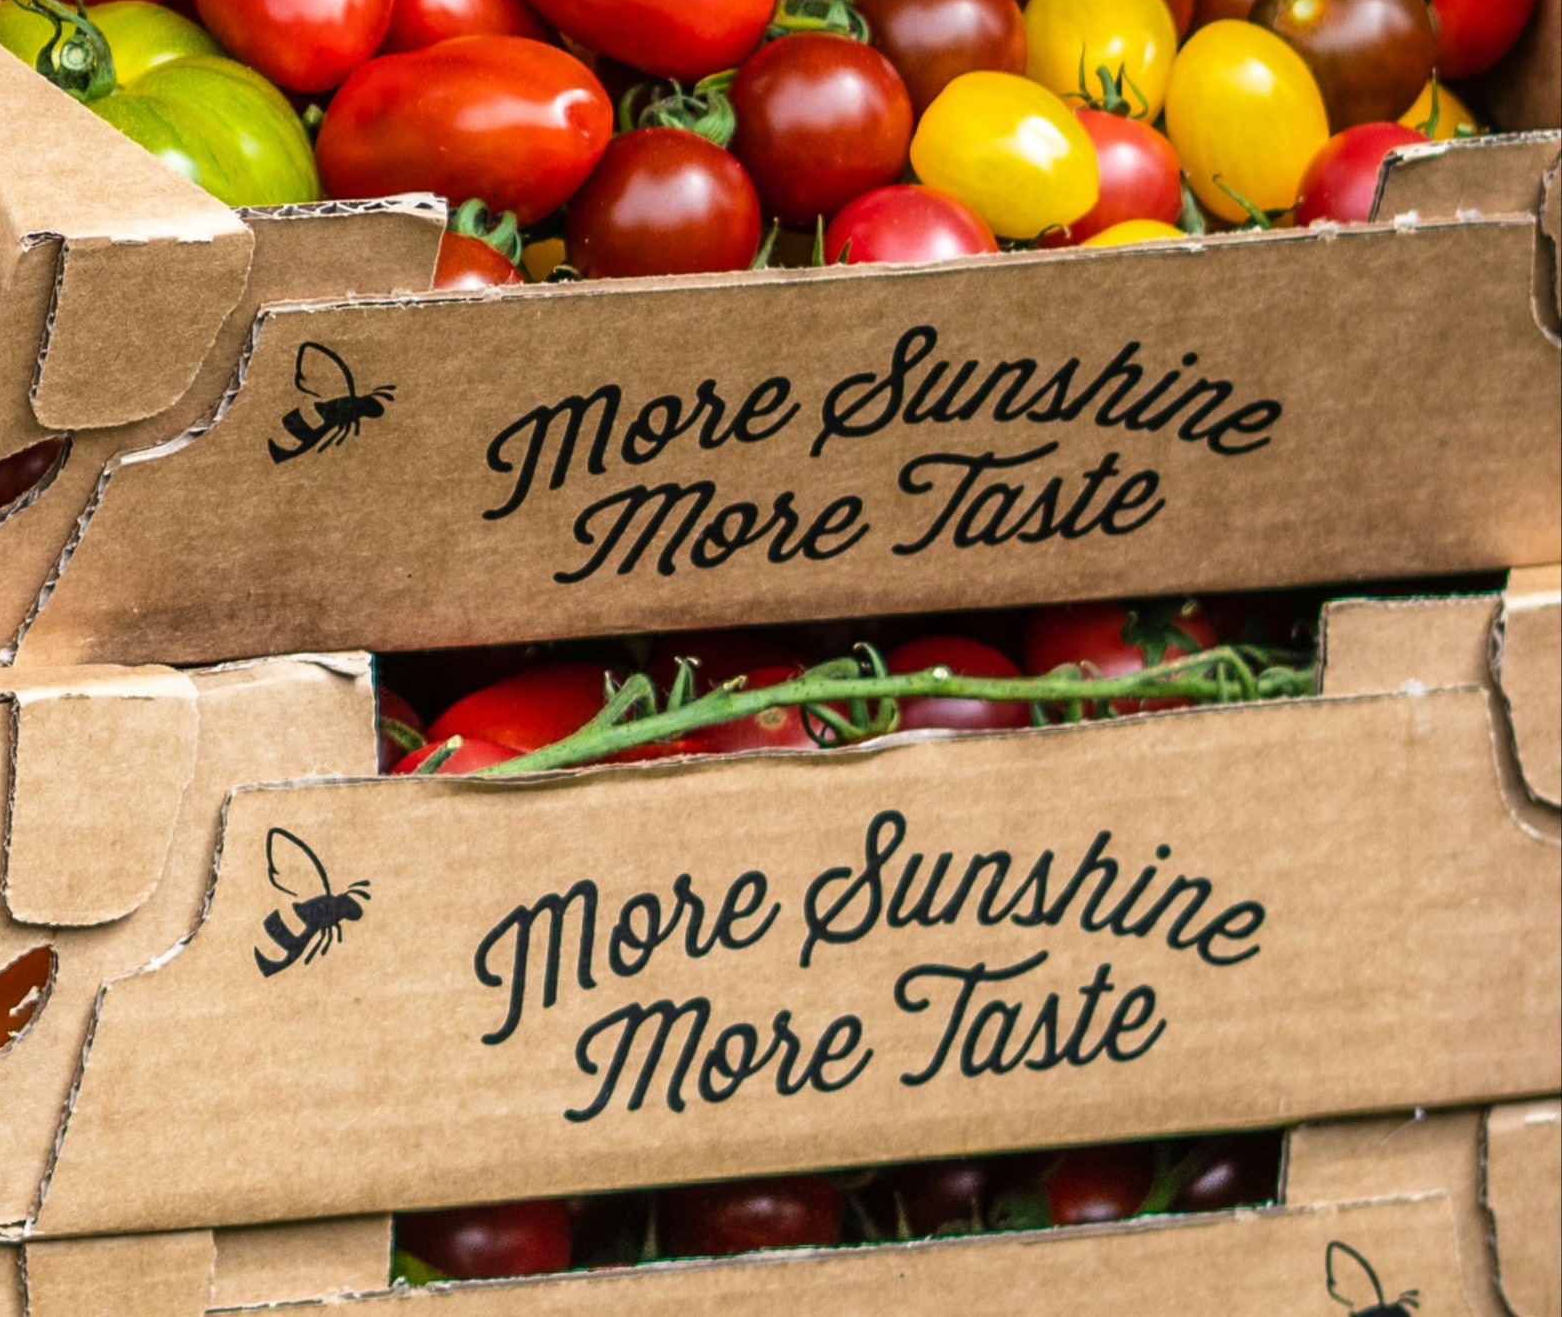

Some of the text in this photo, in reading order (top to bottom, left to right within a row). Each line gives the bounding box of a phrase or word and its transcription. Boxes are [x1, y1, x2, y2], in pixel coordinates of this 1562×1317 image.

[482, 325, 1285, 522] More Sunshine
[552, 440, 1168, 585] More Taste
[474, 810, 1267, 1046] More Sunshine
[564, 950, 1168, 1123] More Taste
